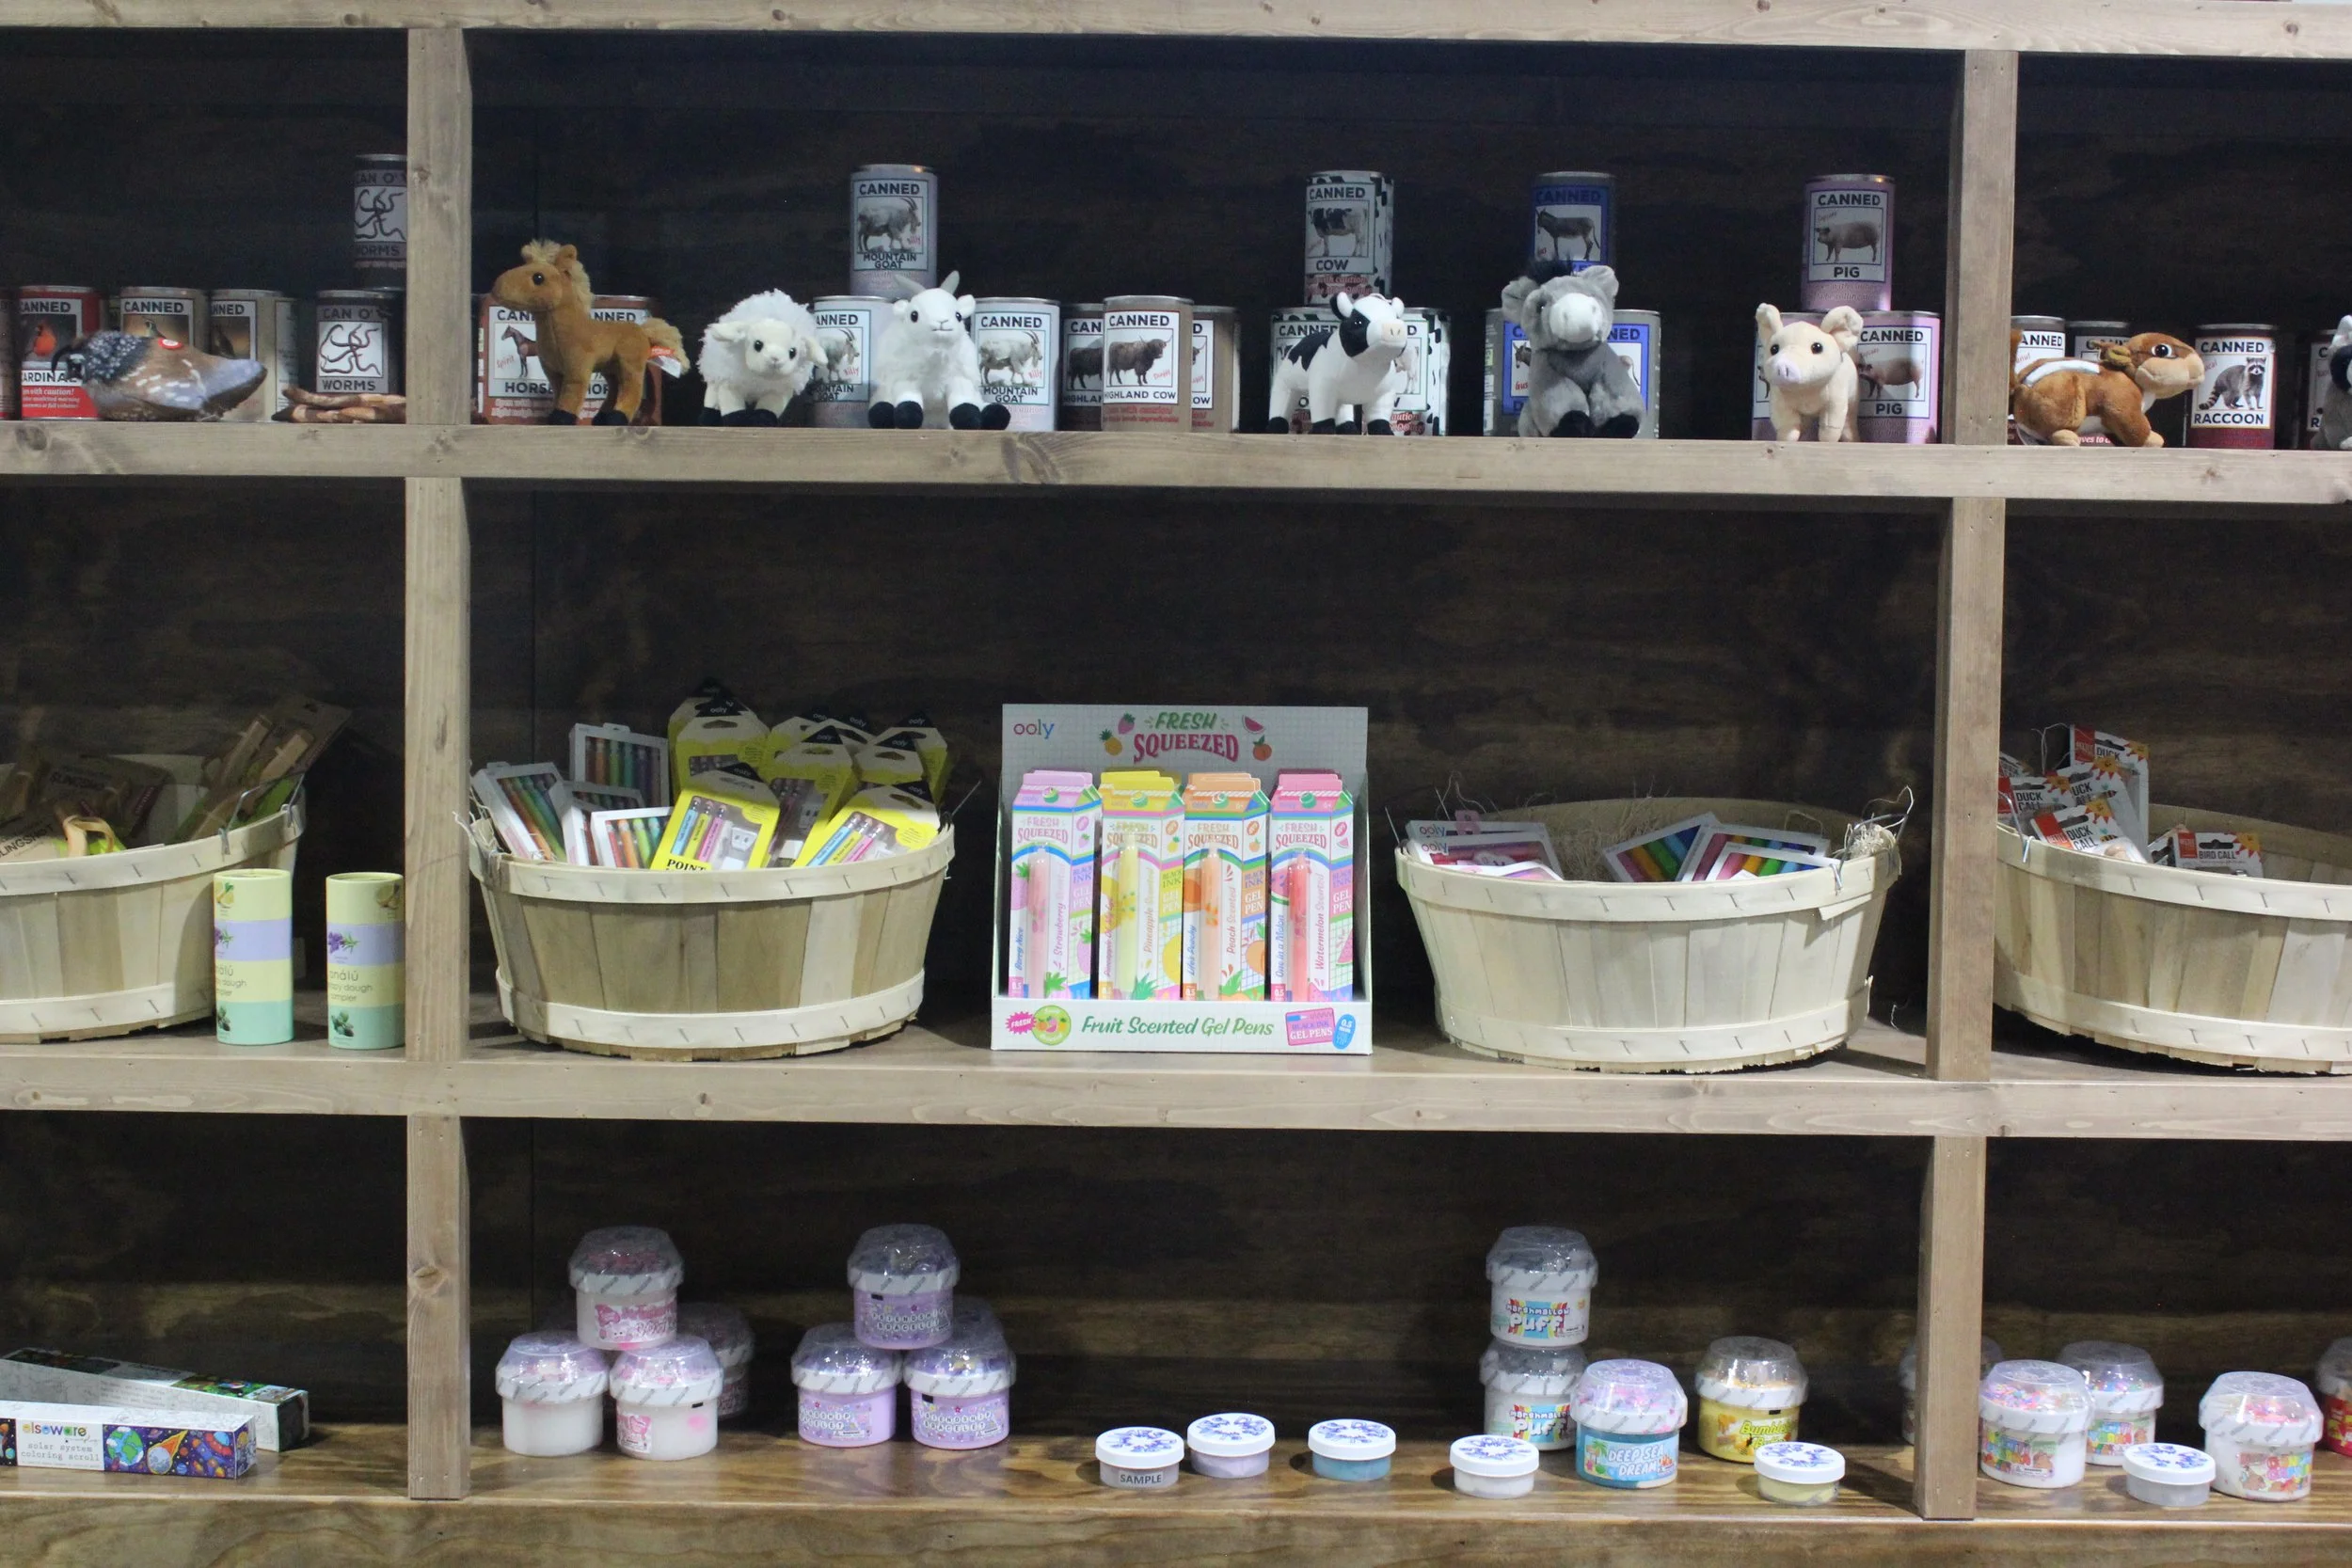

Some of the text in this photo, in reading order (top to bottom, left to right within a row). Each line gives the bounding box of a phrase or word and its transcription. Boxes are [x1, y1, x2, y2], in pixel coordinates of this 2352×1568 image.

[860, 183, 920, 195] CANNED
[1309, 187, 1366, 199] CANNED
[1535, 190, 1601, 203] CANNED
[1817, 194, 1881, 205] CANNED
[864, 254, 917, 262] MOUNTAIN
[1316, 260, 1349, 271] COW
[1834, 266, 1860, 278] PIG
[124, 301, 184, 314] CANNED
[322, 307, 352, 319] CAN
[817, 314, 859, 325] ANNED
[980, 316, 1042, 328] CANNED
[1108, 315, 1169, 327] CANNED
[1608, 327, 1640, 341] NED
[1860, 330, 1924, 342] CANNED
[2022, 335, 2063, 347] ANNED
[2201, 341, 2265, 354] CANNED
[323, 379, 376, 391] WORMS
[983, 387, 1039, 396] MOUNTAIN
[1104, 391, 1176, 401] HIGHLAND COW
[995, 395, 1025, 404] GOAT
[1193, 397, 1211, 405] OW
[1875, 404, 1902, 415] PIG
[2194, 414, 2264, 425] RACCOON
[711, 705, 728, 714] ooly
[1154, 711, 1217, 730] FRESH
[1013, 719, 1055, 739] ooly
[1133, 734, 1240, 764] SQUEEZED
[2016, 791, 2043, 801] DUCK
[2073, 783, 2093, 797] UCK
[1026, 816, 1060, 828] FRESH
[1197, 822, 1231, 833] FRESH
[1285, 822, 1318, 833] FRESH
[1419, 824, 1446, 836] ooly
[2067, 827, 2093, 841] DUCK
[1017, 827, 1069, 846] SQUEEZED
[1275, 833, 1327, 850] SQUEEZED
[2074, 836, 2099, 851] CALL
[2199, 850, 2236, 860] BIRD CALL
[1073, 875, 1092, 884] INK
[1162, 879, 1182, 888] INK
[1245, 879, 1263, 889] INK
[1245, 890, 1263, 904] GEL
[1332, 890, 1351, 903] GEL
[1245, 900, 1264, 915] PEN
[1332, 900, 1352, 915] PEN
[1227, 886, 1236, 955] Peach Scented
[1314, 873, 1325, 971] Watermelon Scented
[1054, 903, 1066, 957] Strawberry
[1143, 907, 1155, 954] Pineapple
[1276, 914, 1285, 941] Melon
[1014, 927, 1025, 971] Berry Nice
[1276, 950, 1284, 960] in
[1276, 962, 1285, 978] One
[344, 984, 373, 995] dough
[1274, 988, 1285, 997] 0.5
[1082, 1015, 1275, 1037] Fruit Scented Gel Pens
[1341, 1019, 1352, 1027] 0.5
[1290, 1028, 1333, 1040] GEL PENS
[23, 1421, 87, 1437] elseware
[27, 1442, 93, 1455] solar system
[1608, 1444, 1664, 1463] DEEP SEA
[21, 1450, 101, 1462] coloring scroll
[1120, 1473, 1162, 1485] SAMPLE
